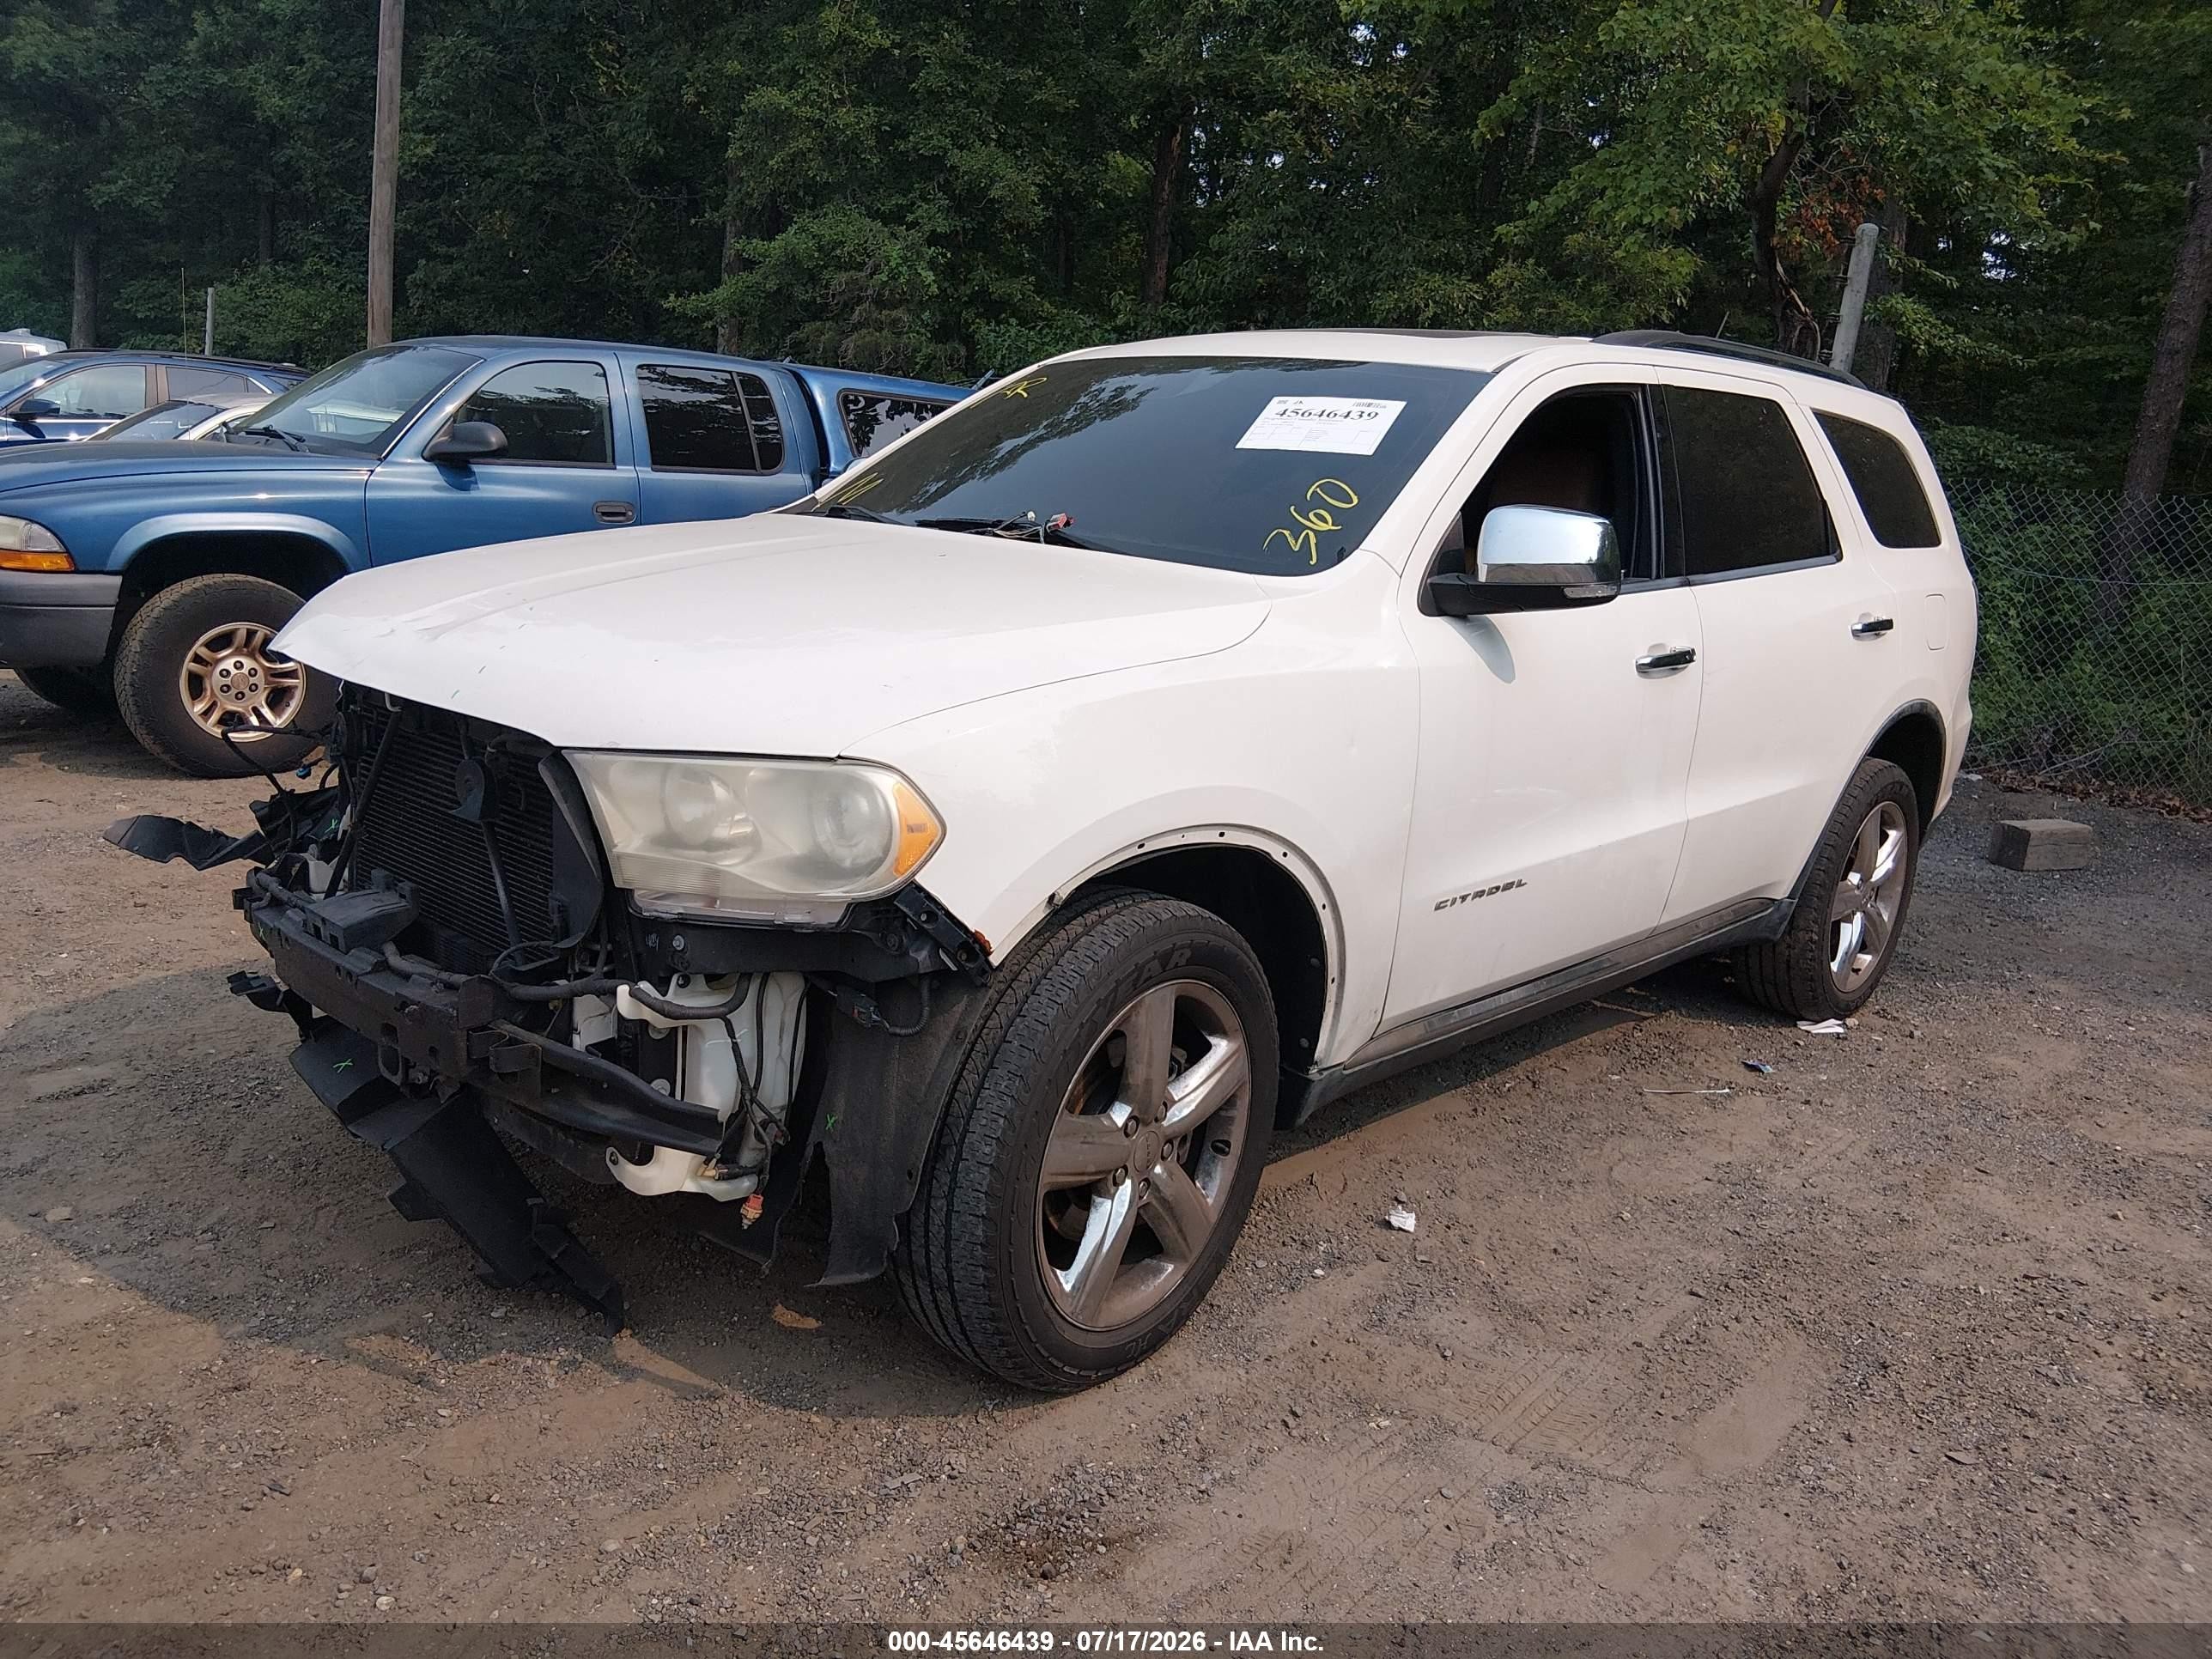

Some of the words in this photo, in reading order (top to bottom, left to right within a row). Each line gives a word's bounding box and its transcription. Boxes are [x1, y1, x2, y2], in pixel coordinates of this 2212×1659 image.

[1275, 408, 1379, 421] 45646439
[1263, 478, 1358, 565] 360
[1434, 878, 1528, 911] CITADEL
